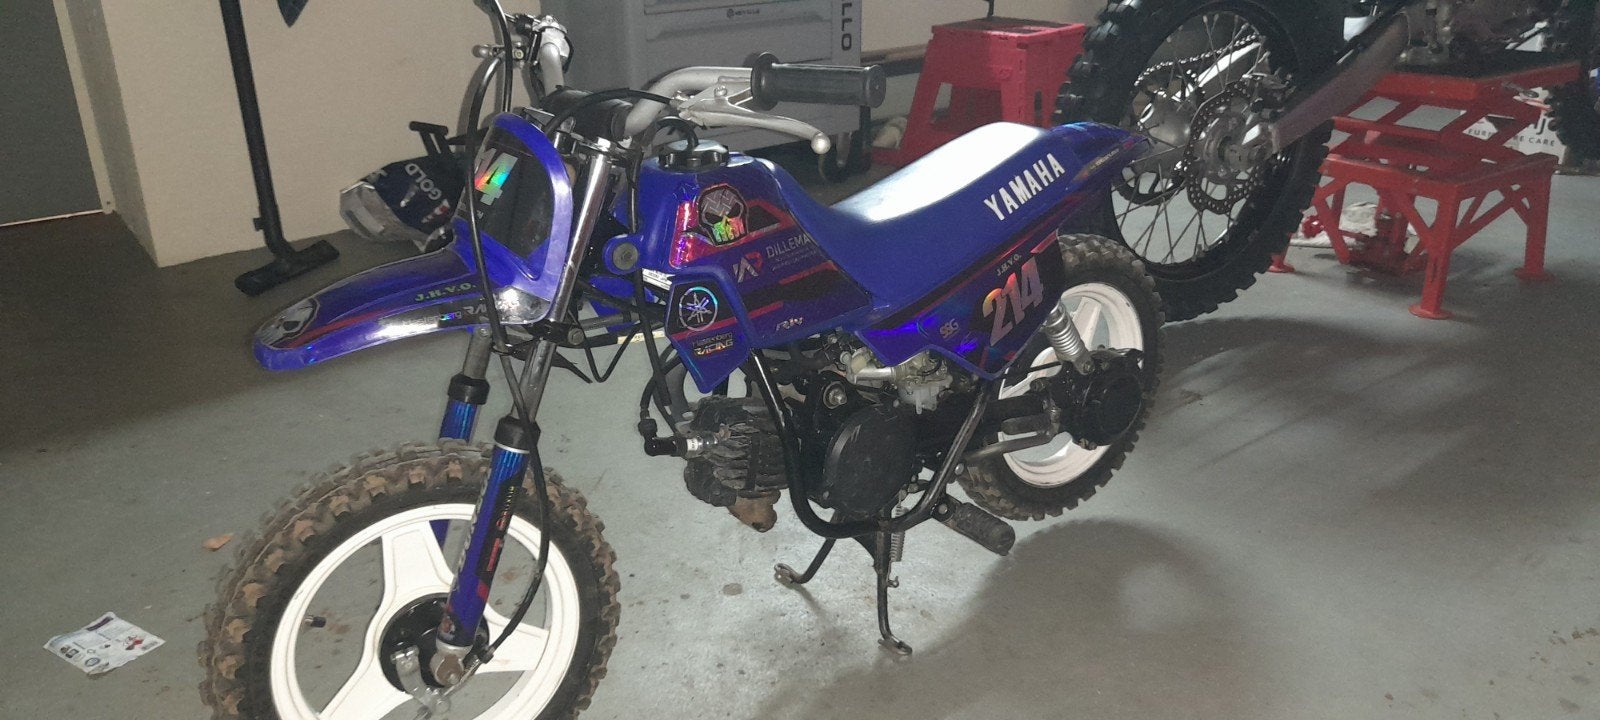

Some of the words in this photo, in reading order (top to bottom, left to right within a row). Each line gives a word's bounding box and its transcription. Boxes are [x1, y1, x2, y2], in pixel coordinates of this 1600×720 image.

[1528, 137, 1555, 147] CARE
[405, 163, 441, 200] GOLD
[983, 153, 1066, 221] YAMAHA
[982, 256, 1044, 346] 214
